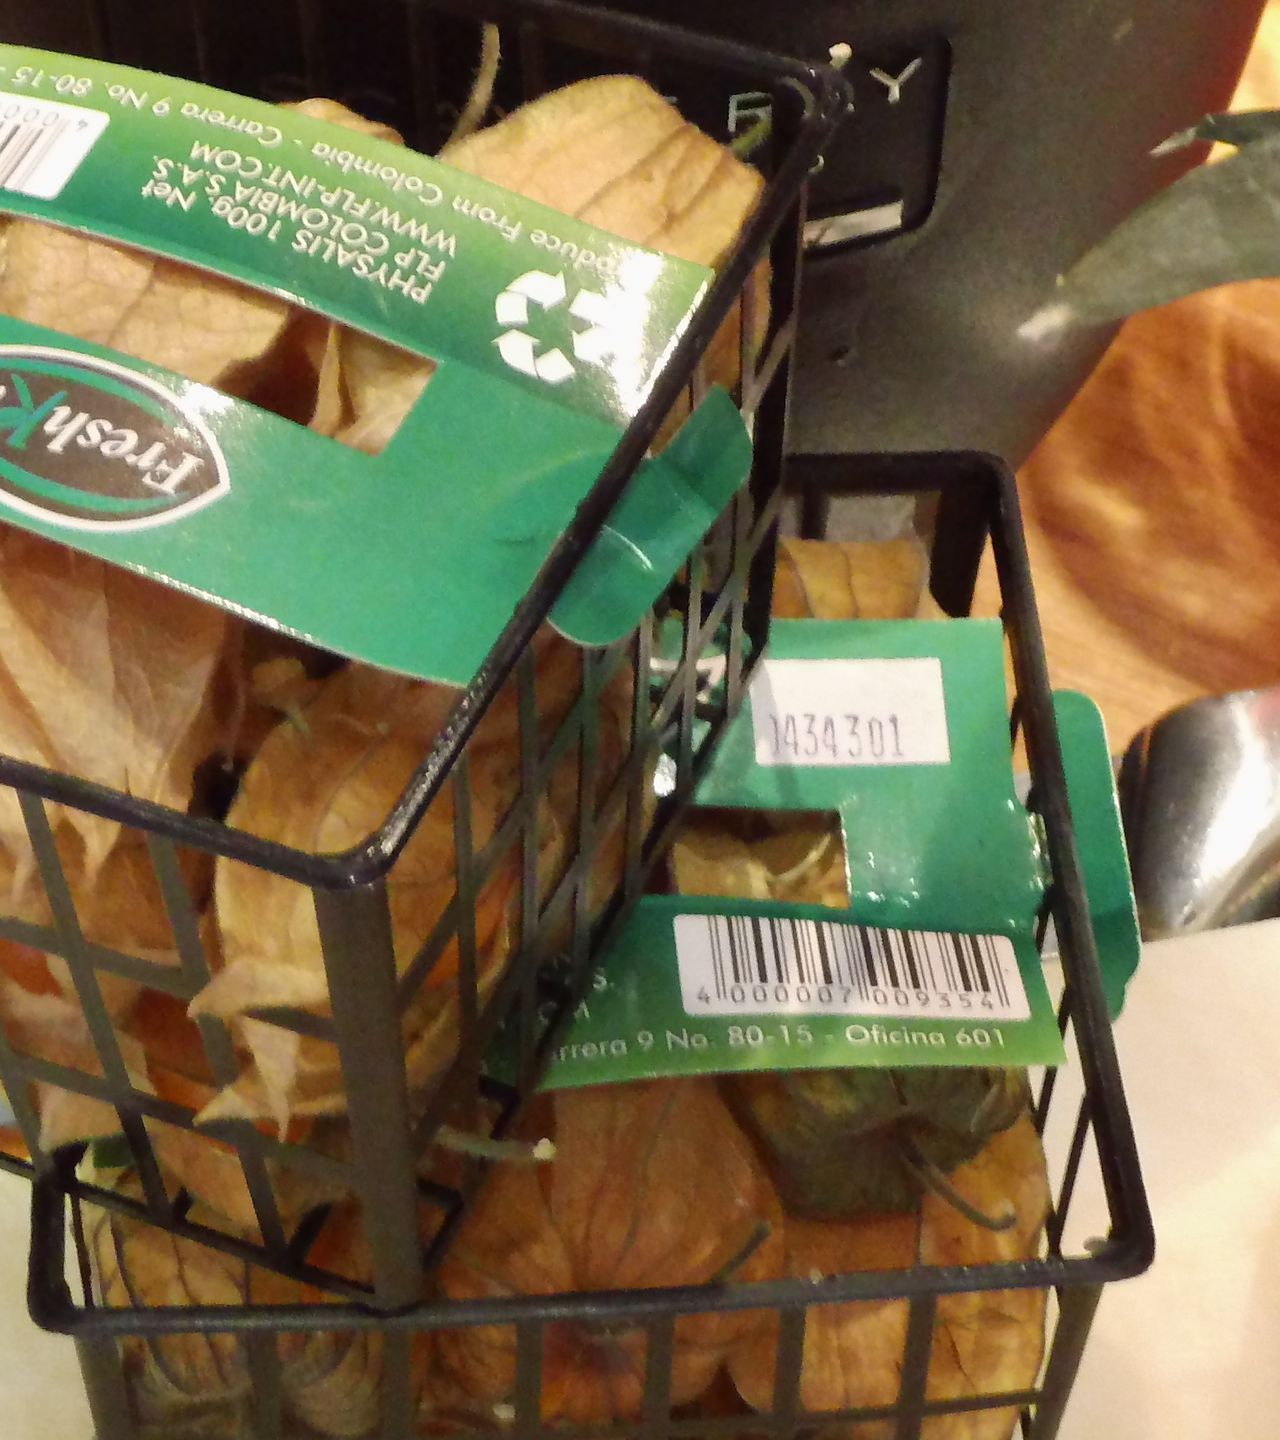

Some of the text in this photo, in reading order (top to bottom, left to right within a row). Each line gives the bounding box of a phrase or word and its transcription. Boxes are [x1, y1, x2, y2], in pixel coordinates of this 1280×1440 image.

[14, 65, 93, 97] 80-15
[103, 80, 150, 110] No.
[151, 96, 171, 119] 9
[179, 100, 284, 149] Carrera
[140, 177, 197, 213] Net
[311, 141, 444, 207] Colombia
[151, 154, 446, 283] FLP COLOMBIA S.A.S.
[452, 194, 523, 242] From
[290, 227, 433, 305] PHYSALIS
[636, 1029, 654, 1052] 9
[727, 1024, 814, 1049] 80-15
[844, 1023, 948, 1047] Oficina
[956, 1026, 1006, 1050] 601
